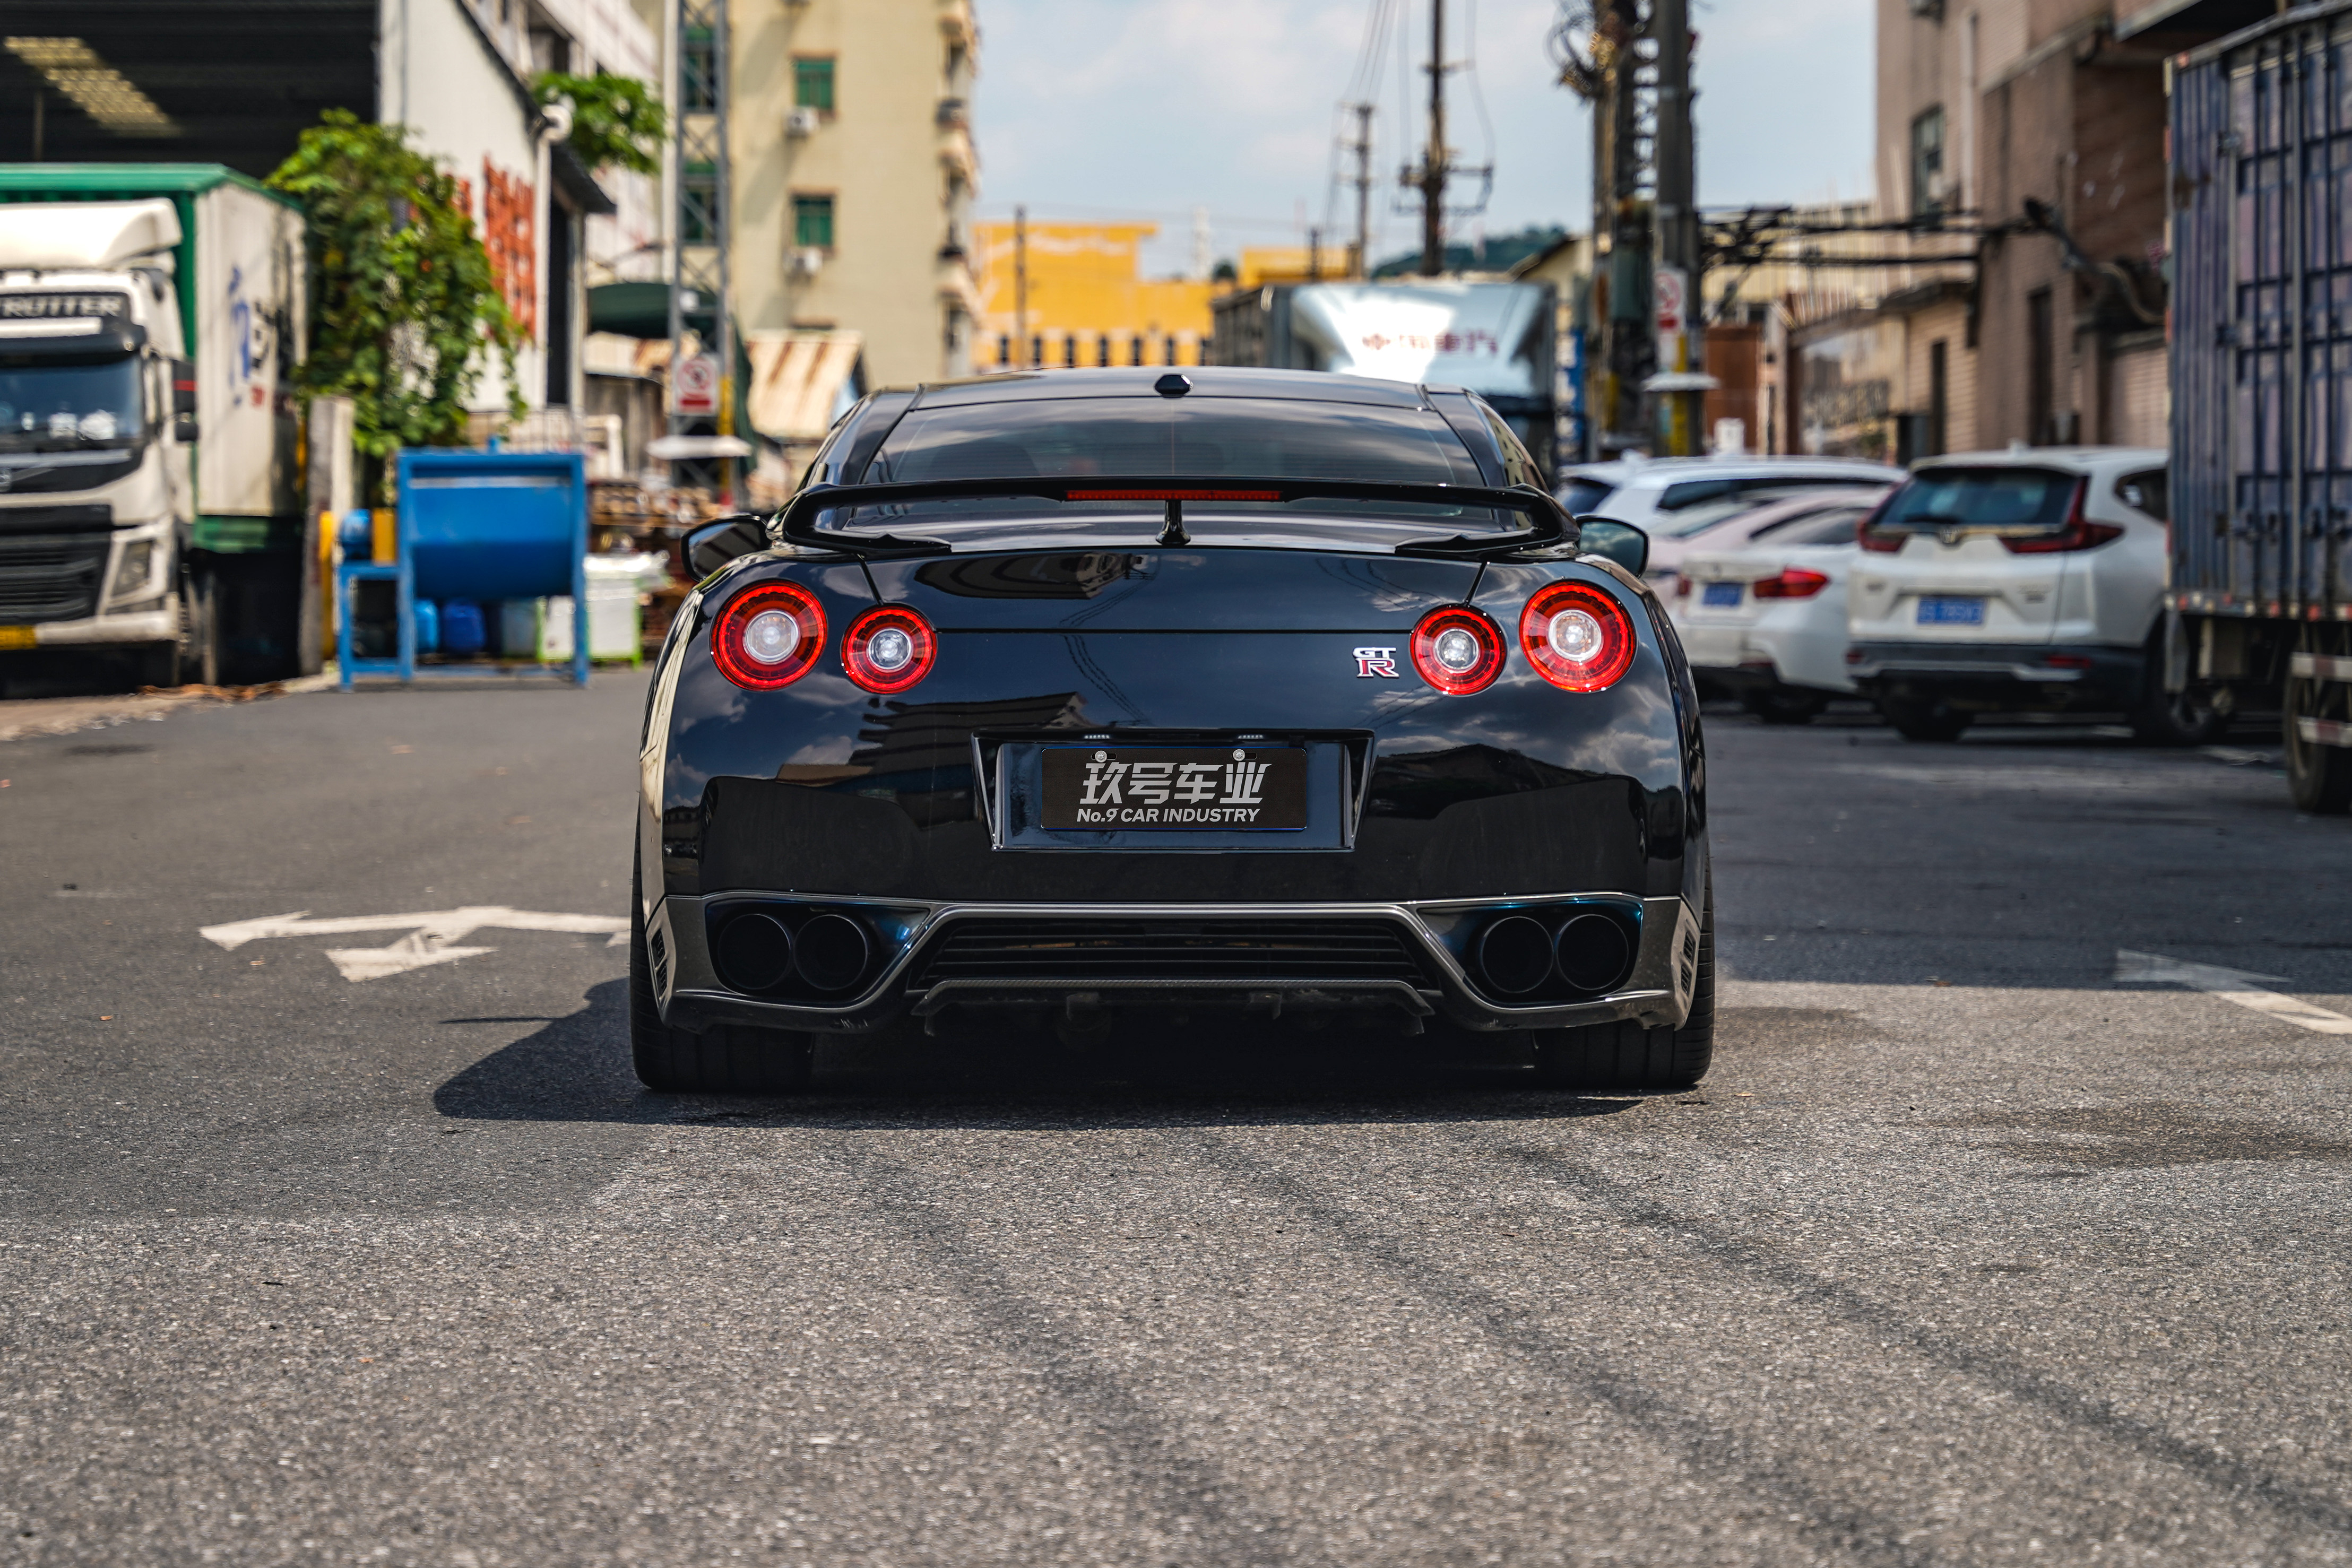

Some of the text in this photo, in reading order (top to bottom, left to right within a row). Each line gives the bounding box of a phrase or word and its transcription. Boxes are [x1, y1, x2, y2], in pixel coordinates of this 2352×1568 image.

[1079, 761, 1273, 804] 玖号车业
[1077, 809, 1260, 822] No.9 CAR INDUSTRY
